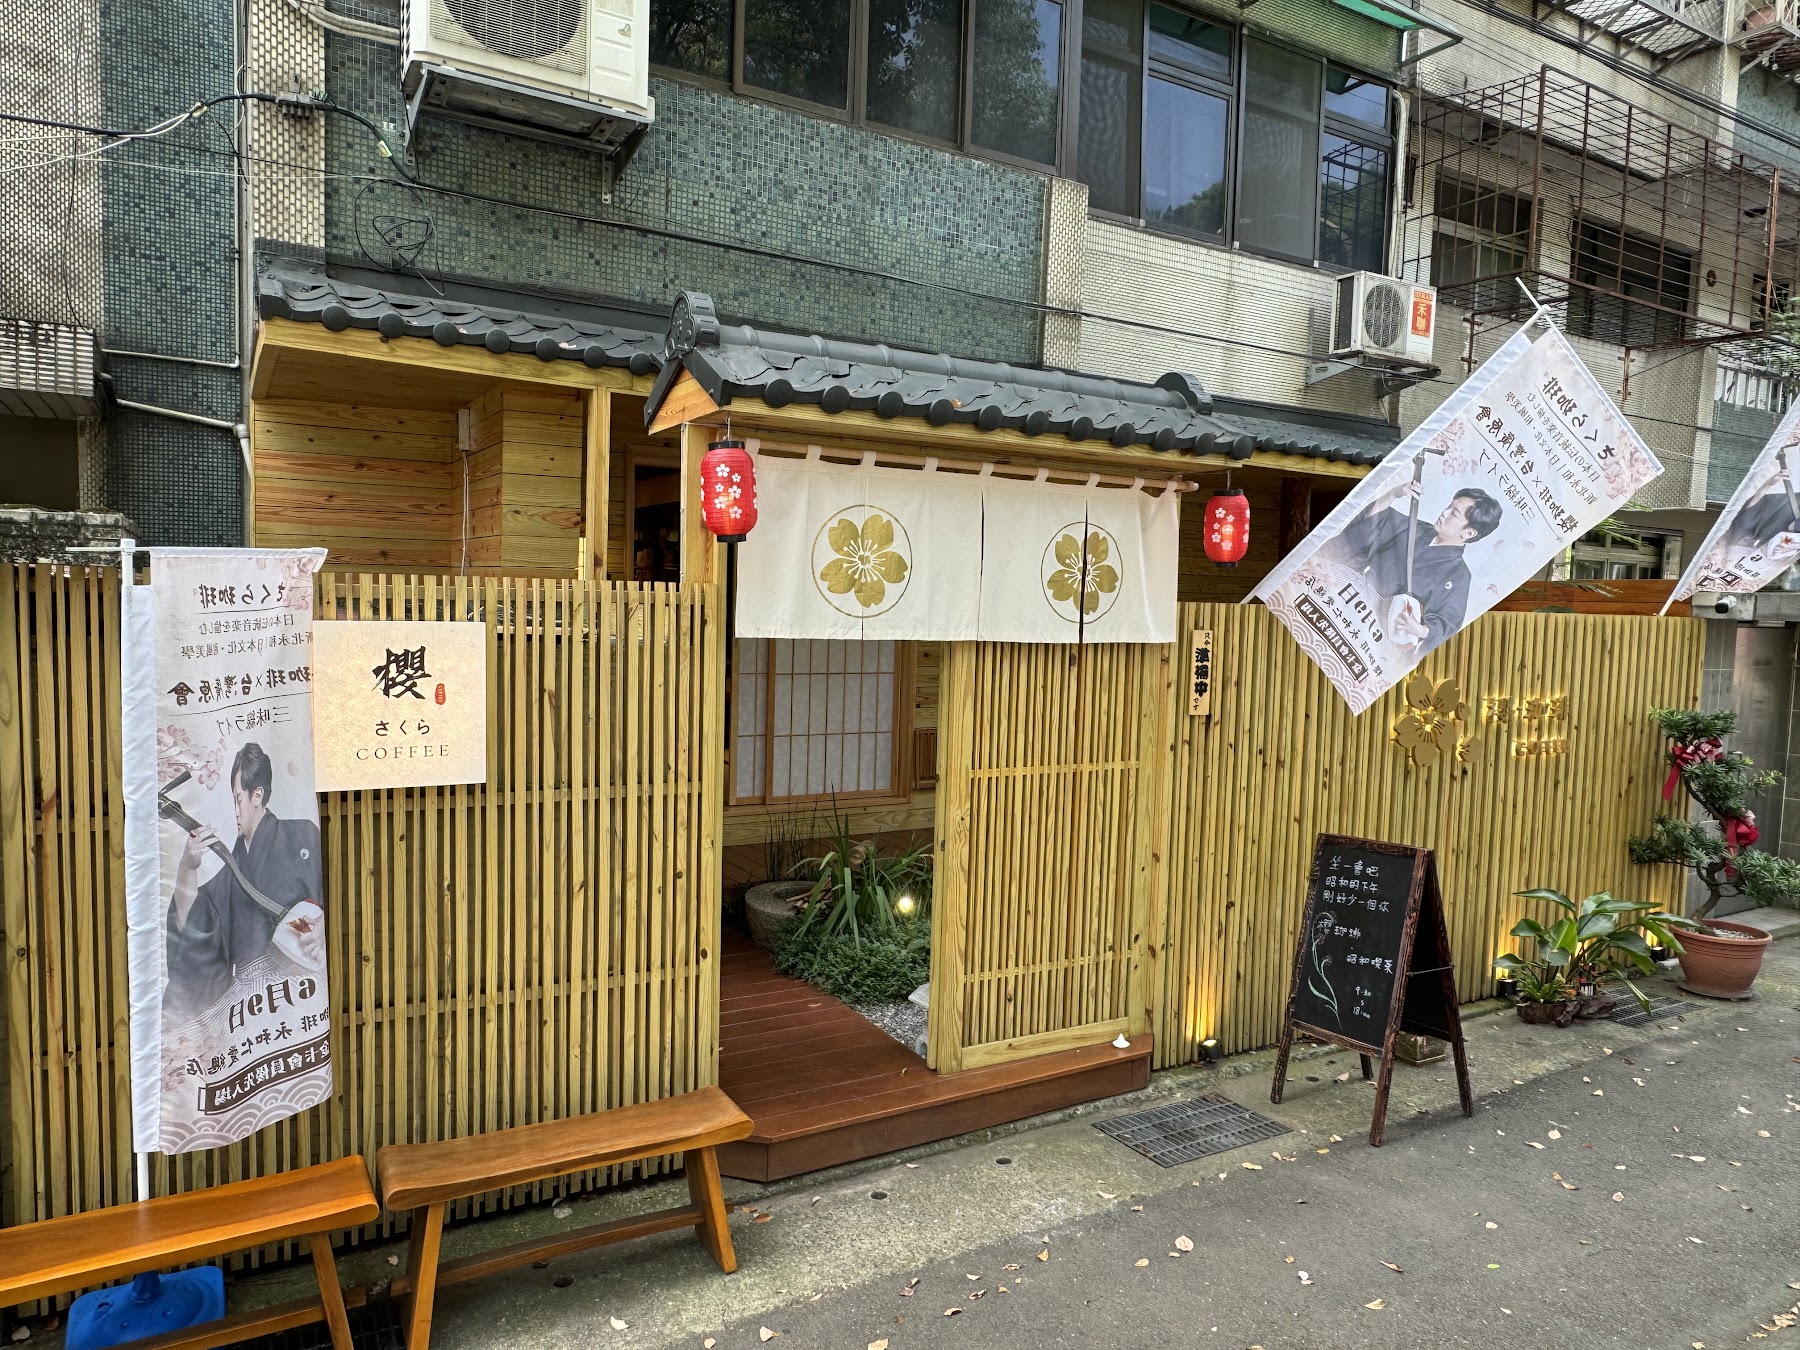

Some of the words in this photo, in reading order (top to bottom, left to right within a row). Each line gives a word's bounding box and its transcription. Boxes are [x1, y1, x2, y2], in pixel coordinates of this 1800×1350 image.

[371, 646, 432, 699] 櫻
[374, 719, 431, 737] さくら
[356, 744, 450, 761] COFFEE
[1325, 875, 1379, 893] 昭和的下午
